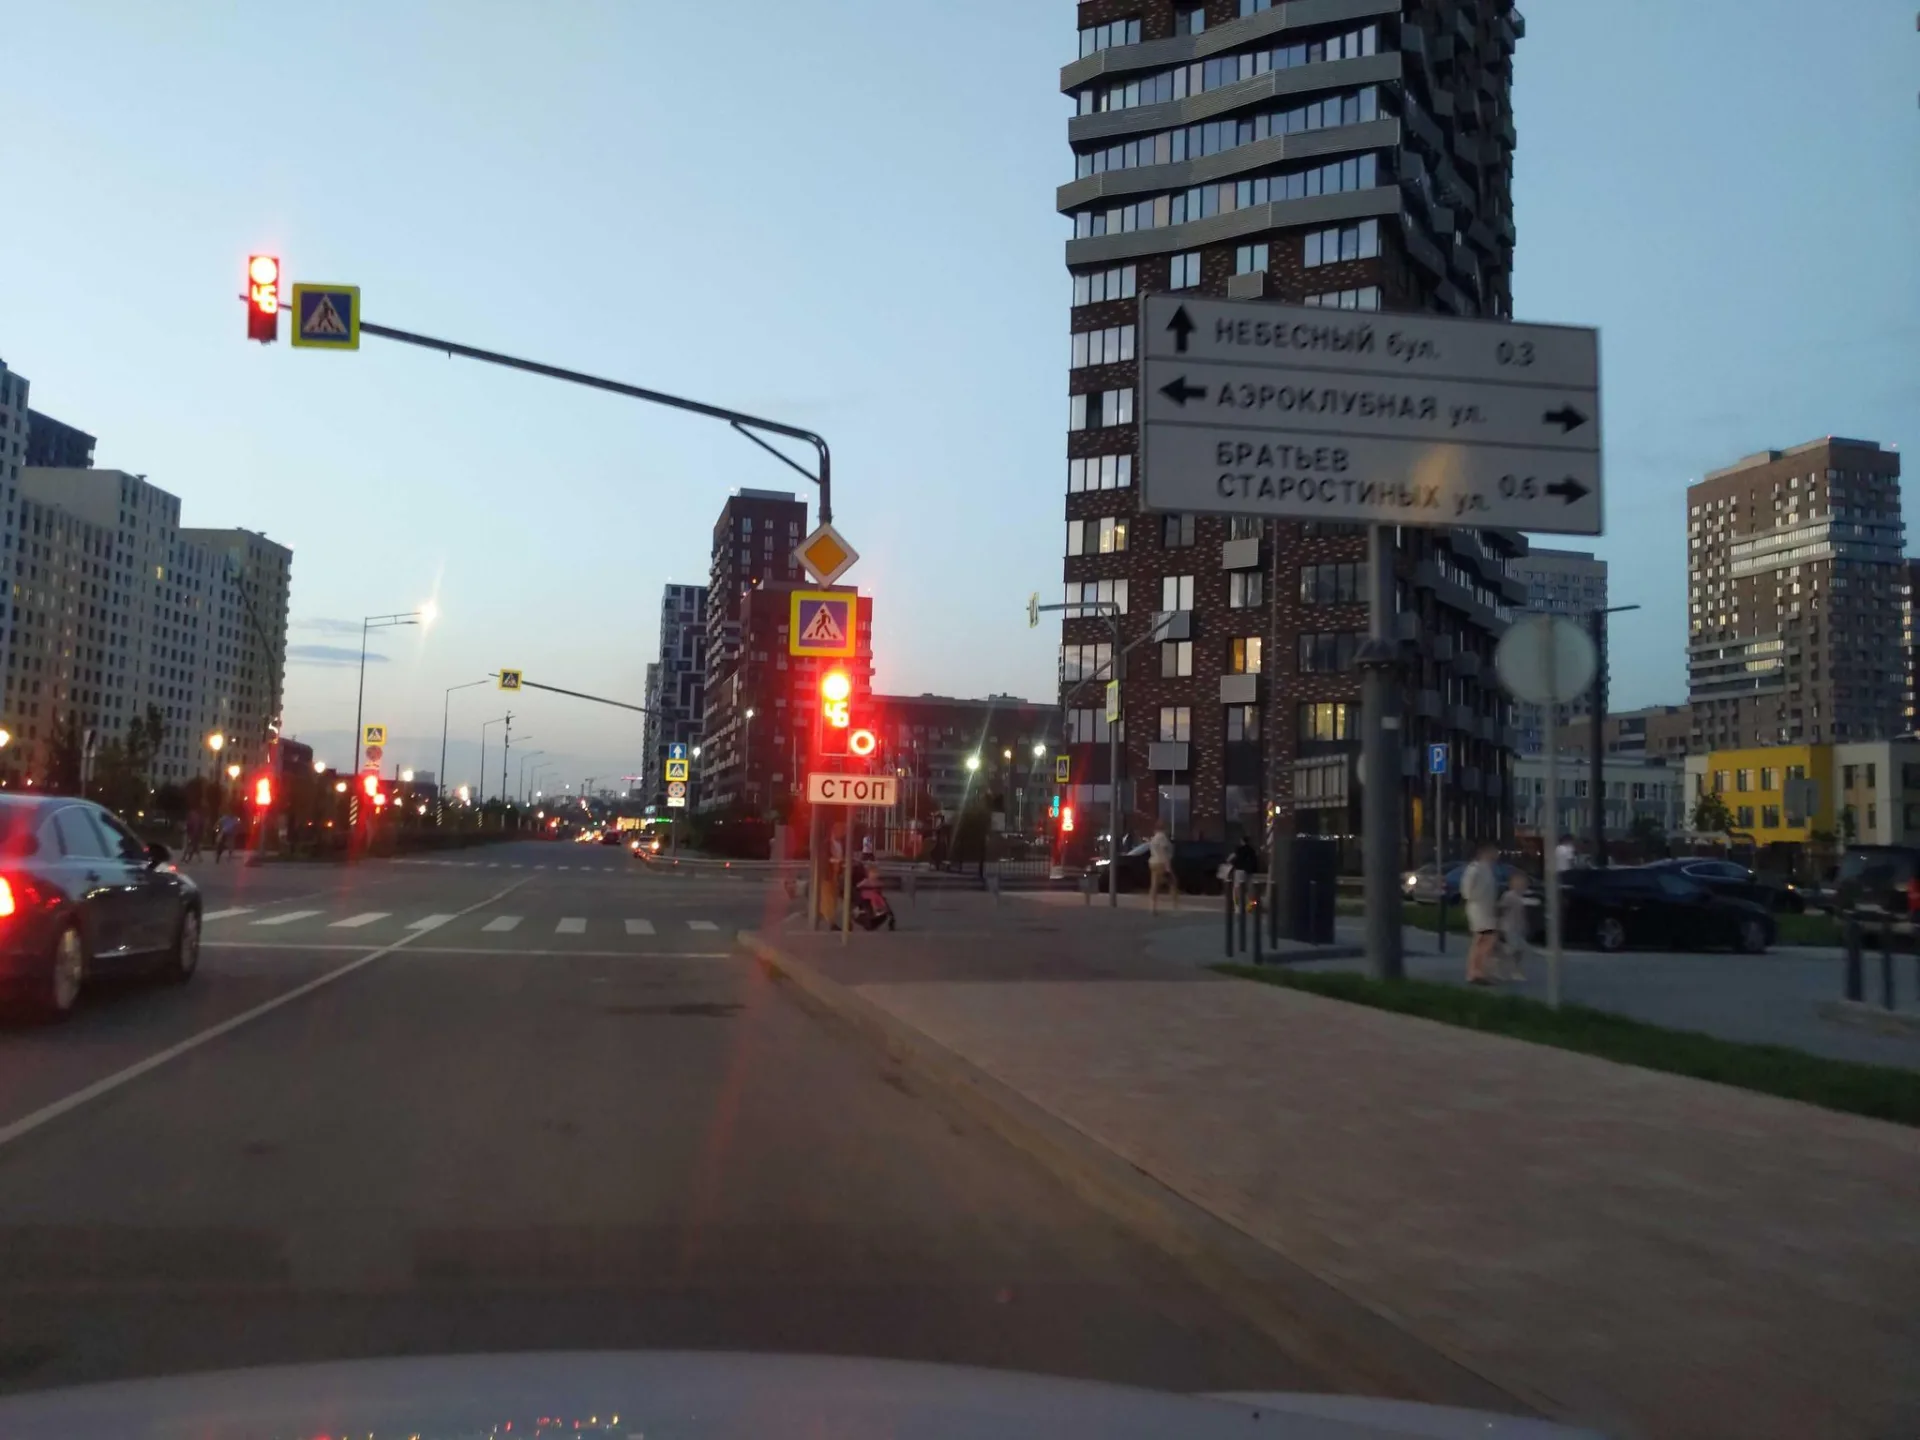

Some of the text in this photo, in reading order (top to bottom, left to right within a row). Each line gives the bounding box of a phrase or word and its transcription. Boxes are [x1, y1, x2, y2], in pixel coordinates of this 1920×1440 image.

[1215, 317, 1375, 354] НЕБЕСНЫЙ
[1387, 332, 1442, 363] бул.
[1217, 382, 1489, 429] АЭРОКЛУБНАЯ ул.
[1217, 441, 1350, 473] БРАТЬЕВ
[1217, 473, 1441, 509] СТАРОСТИНЫХ
[1454, 491, 1491, 517] ул.
[821, 779, 886, 801] СТОП
